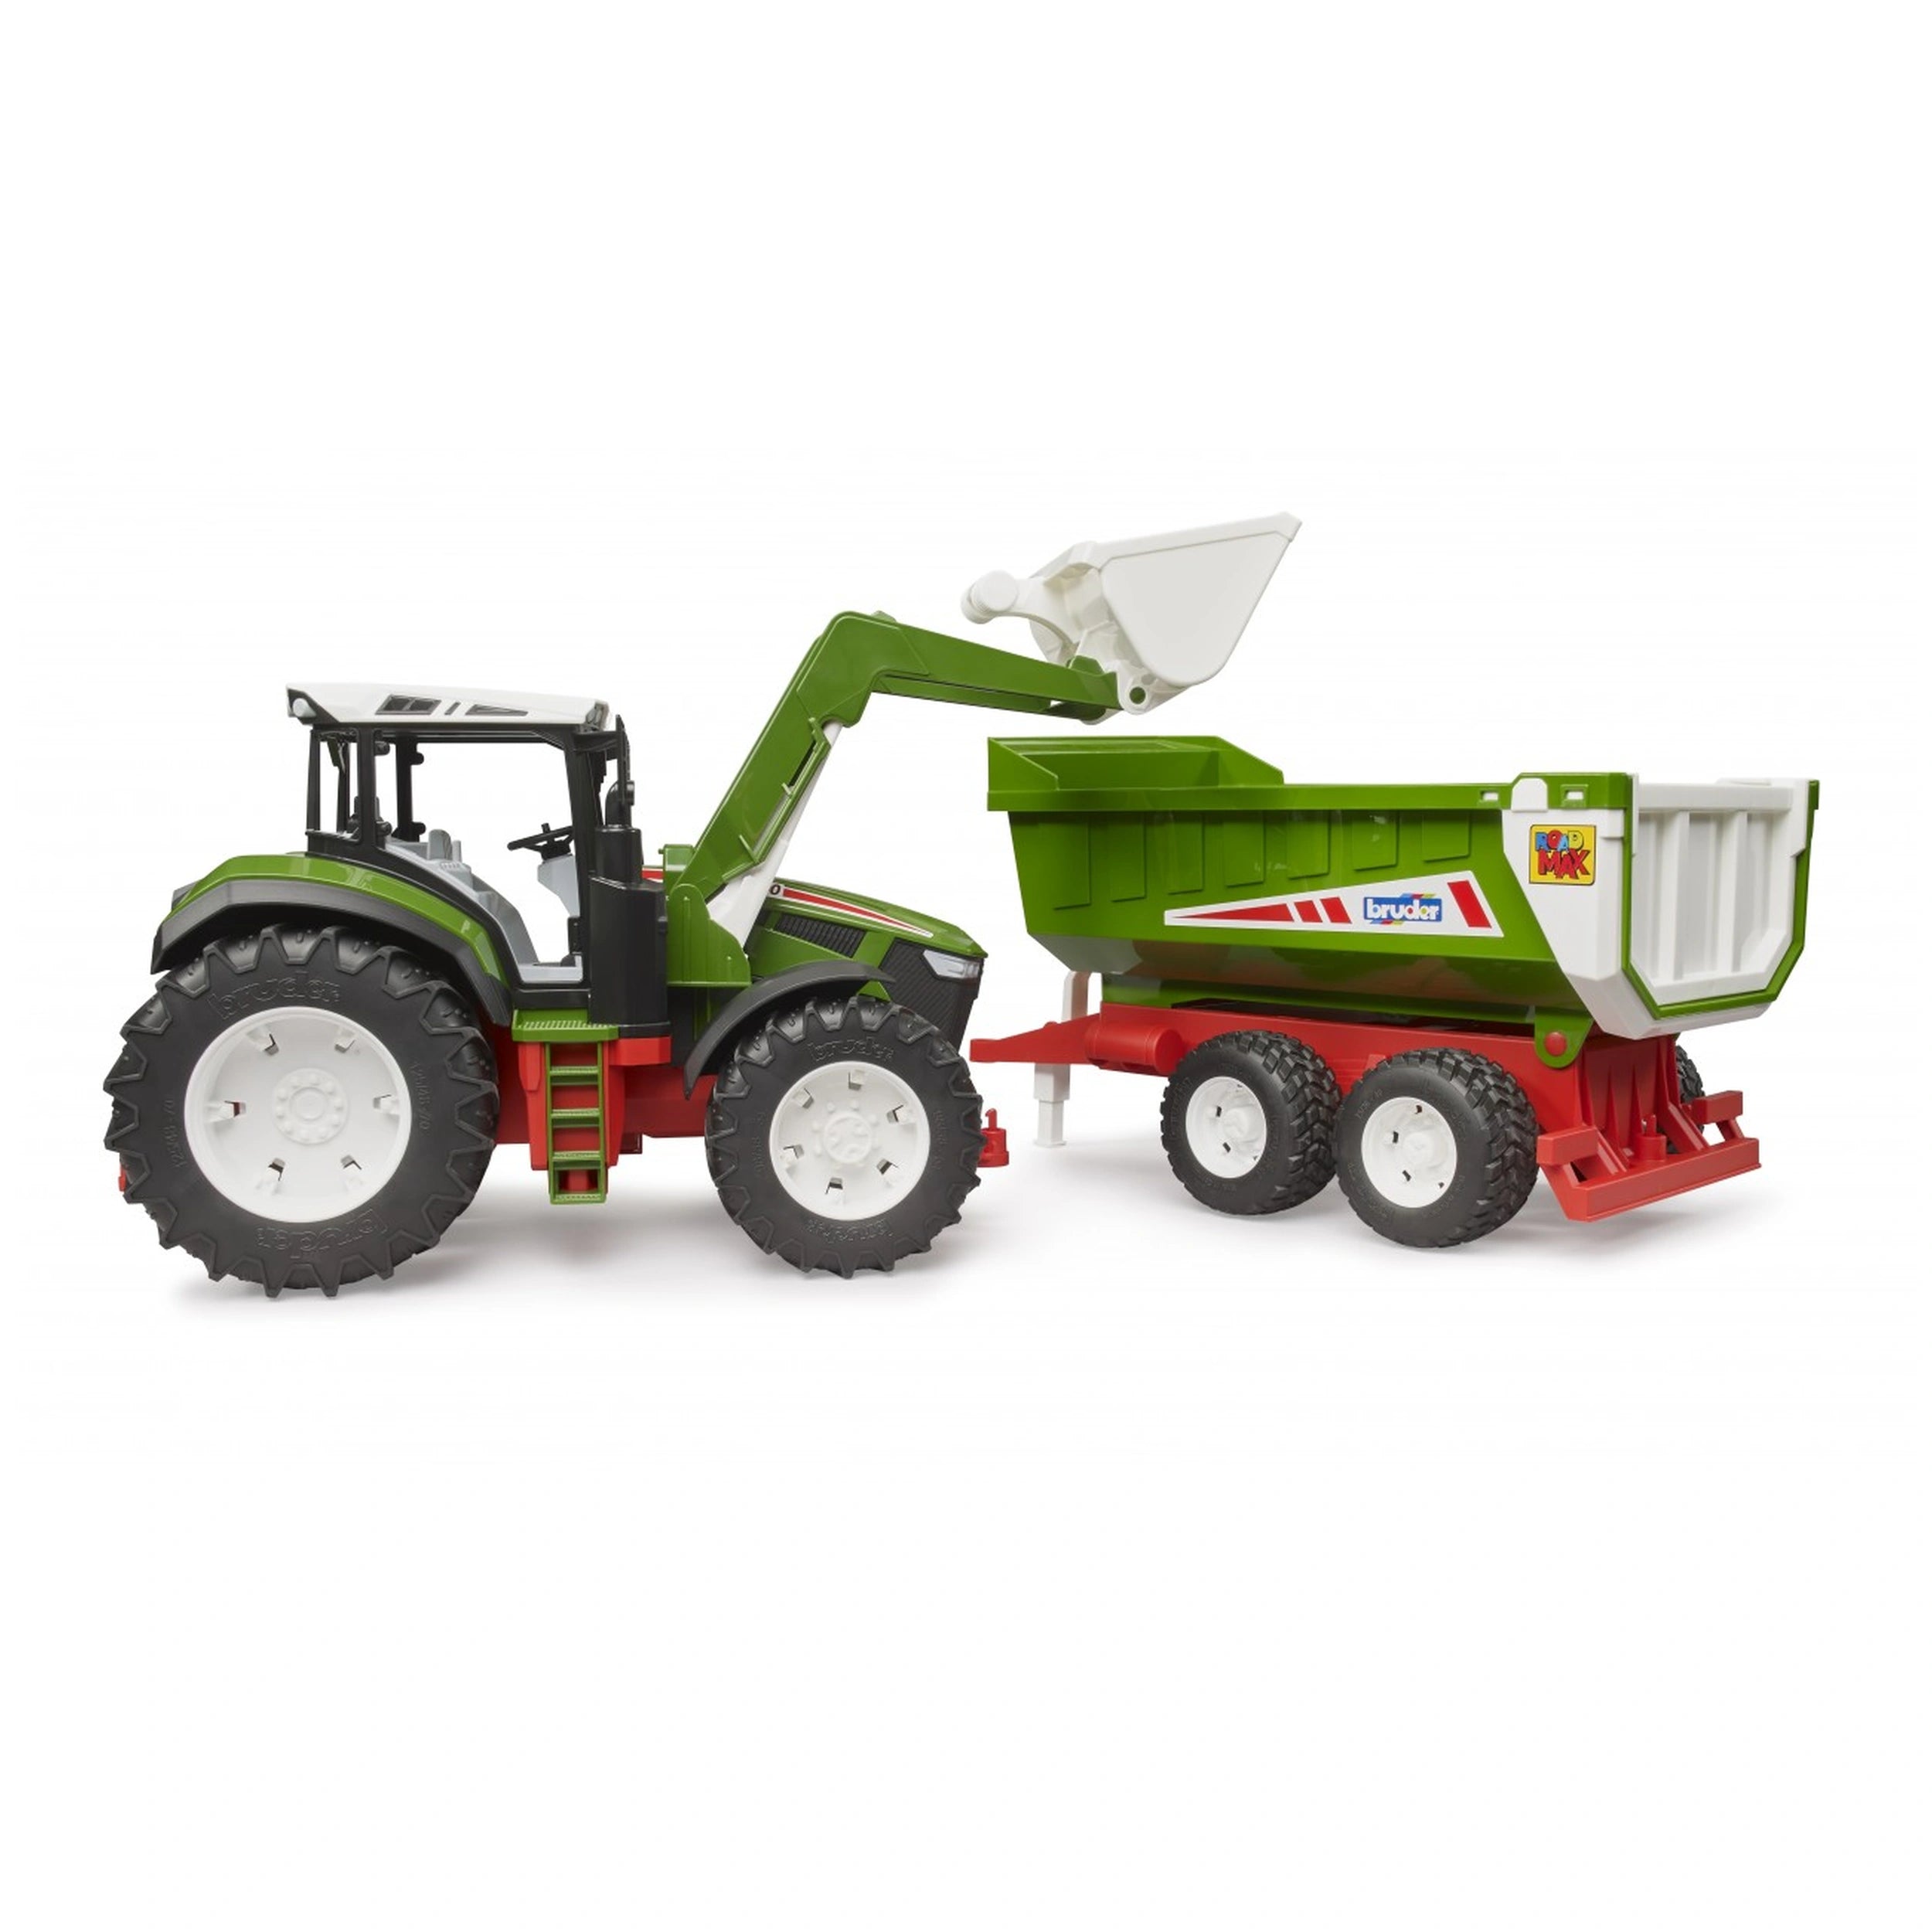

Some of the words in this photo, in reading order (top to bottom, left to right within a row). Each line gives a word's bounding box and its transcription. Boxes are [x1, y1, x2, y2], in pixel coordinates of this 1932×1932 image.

[1535, 829, 1584, 852] ROAD
[1538, 848, 1590, 879] MAX
[1366, 898, 1440, 920] bruder
[207, 971, 341, 1020] bruder
